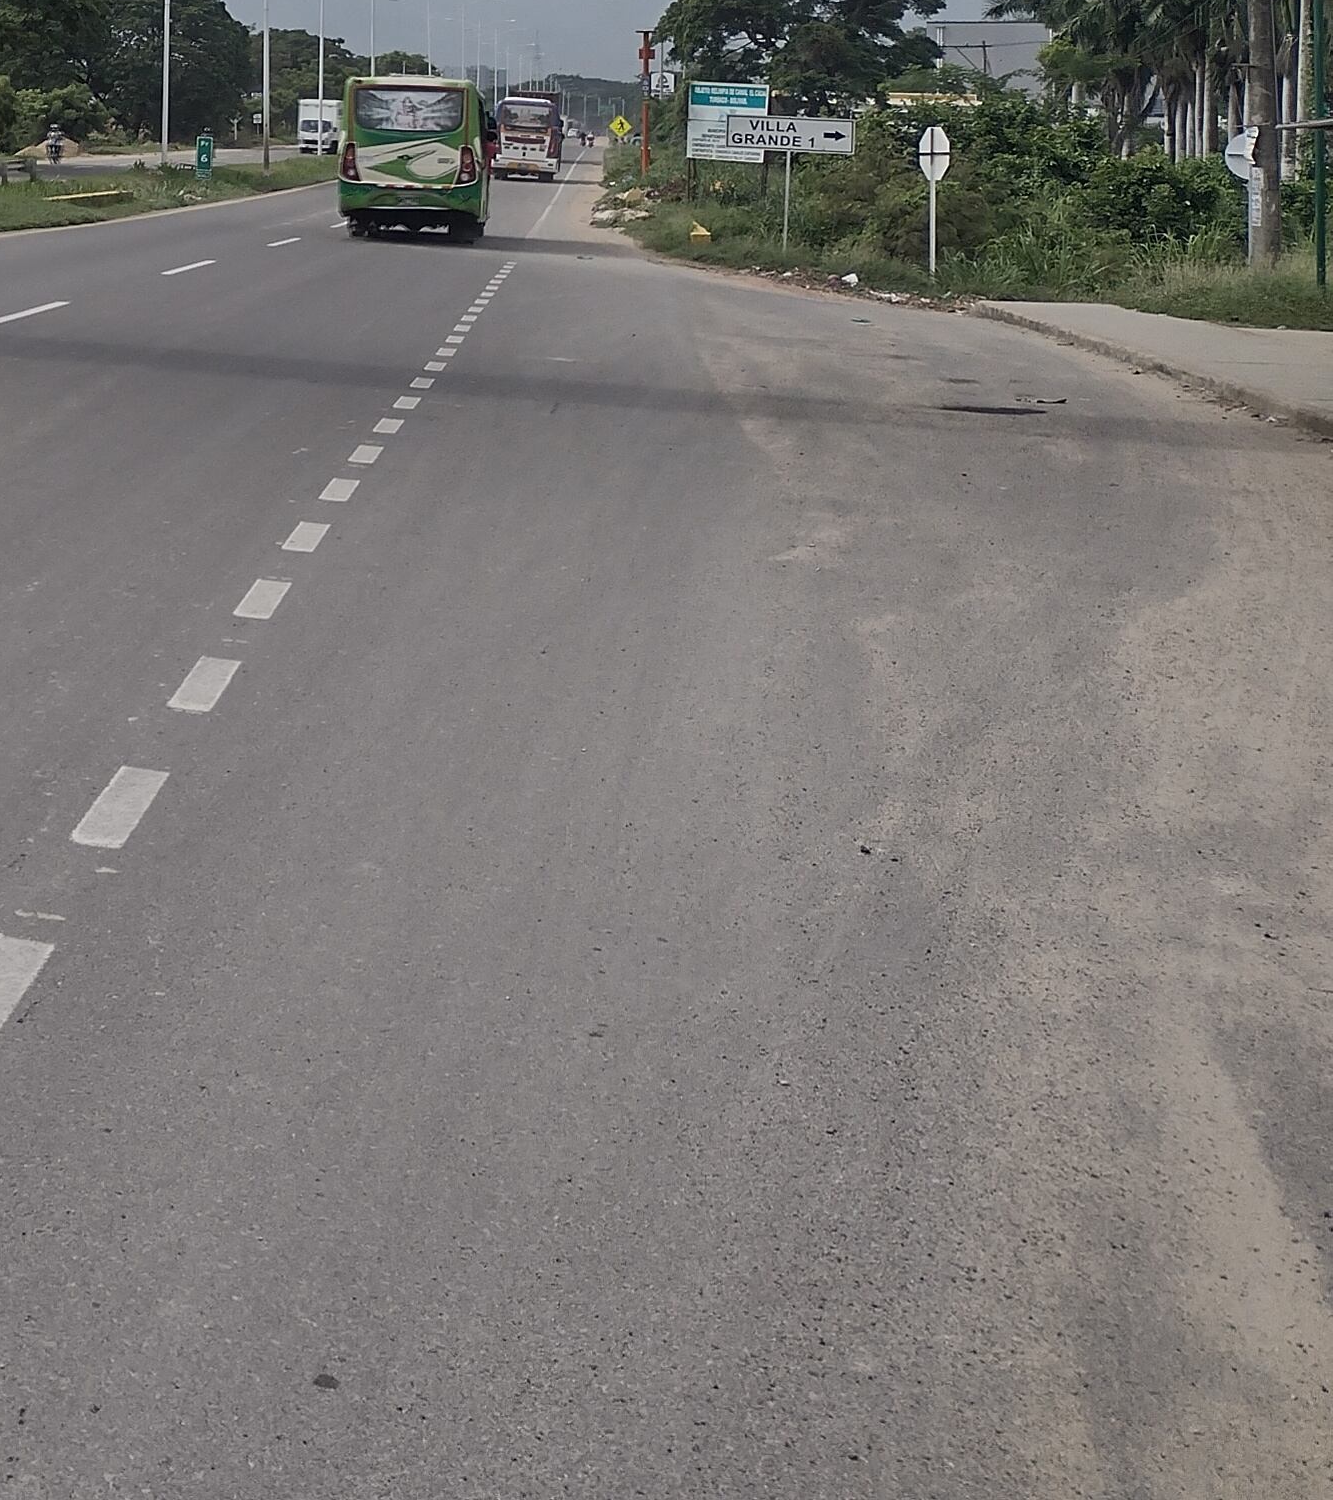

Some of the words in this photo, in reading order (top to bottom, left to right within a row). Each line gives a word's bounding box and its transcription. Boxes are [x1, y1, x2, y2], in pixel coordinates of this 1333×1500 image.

[749, 119, 797, 133] VILLA
[731, 132, 802, 147] GRANDE
[808, 137, 815, 148] 1
[200, 154, 208, 163] 6
